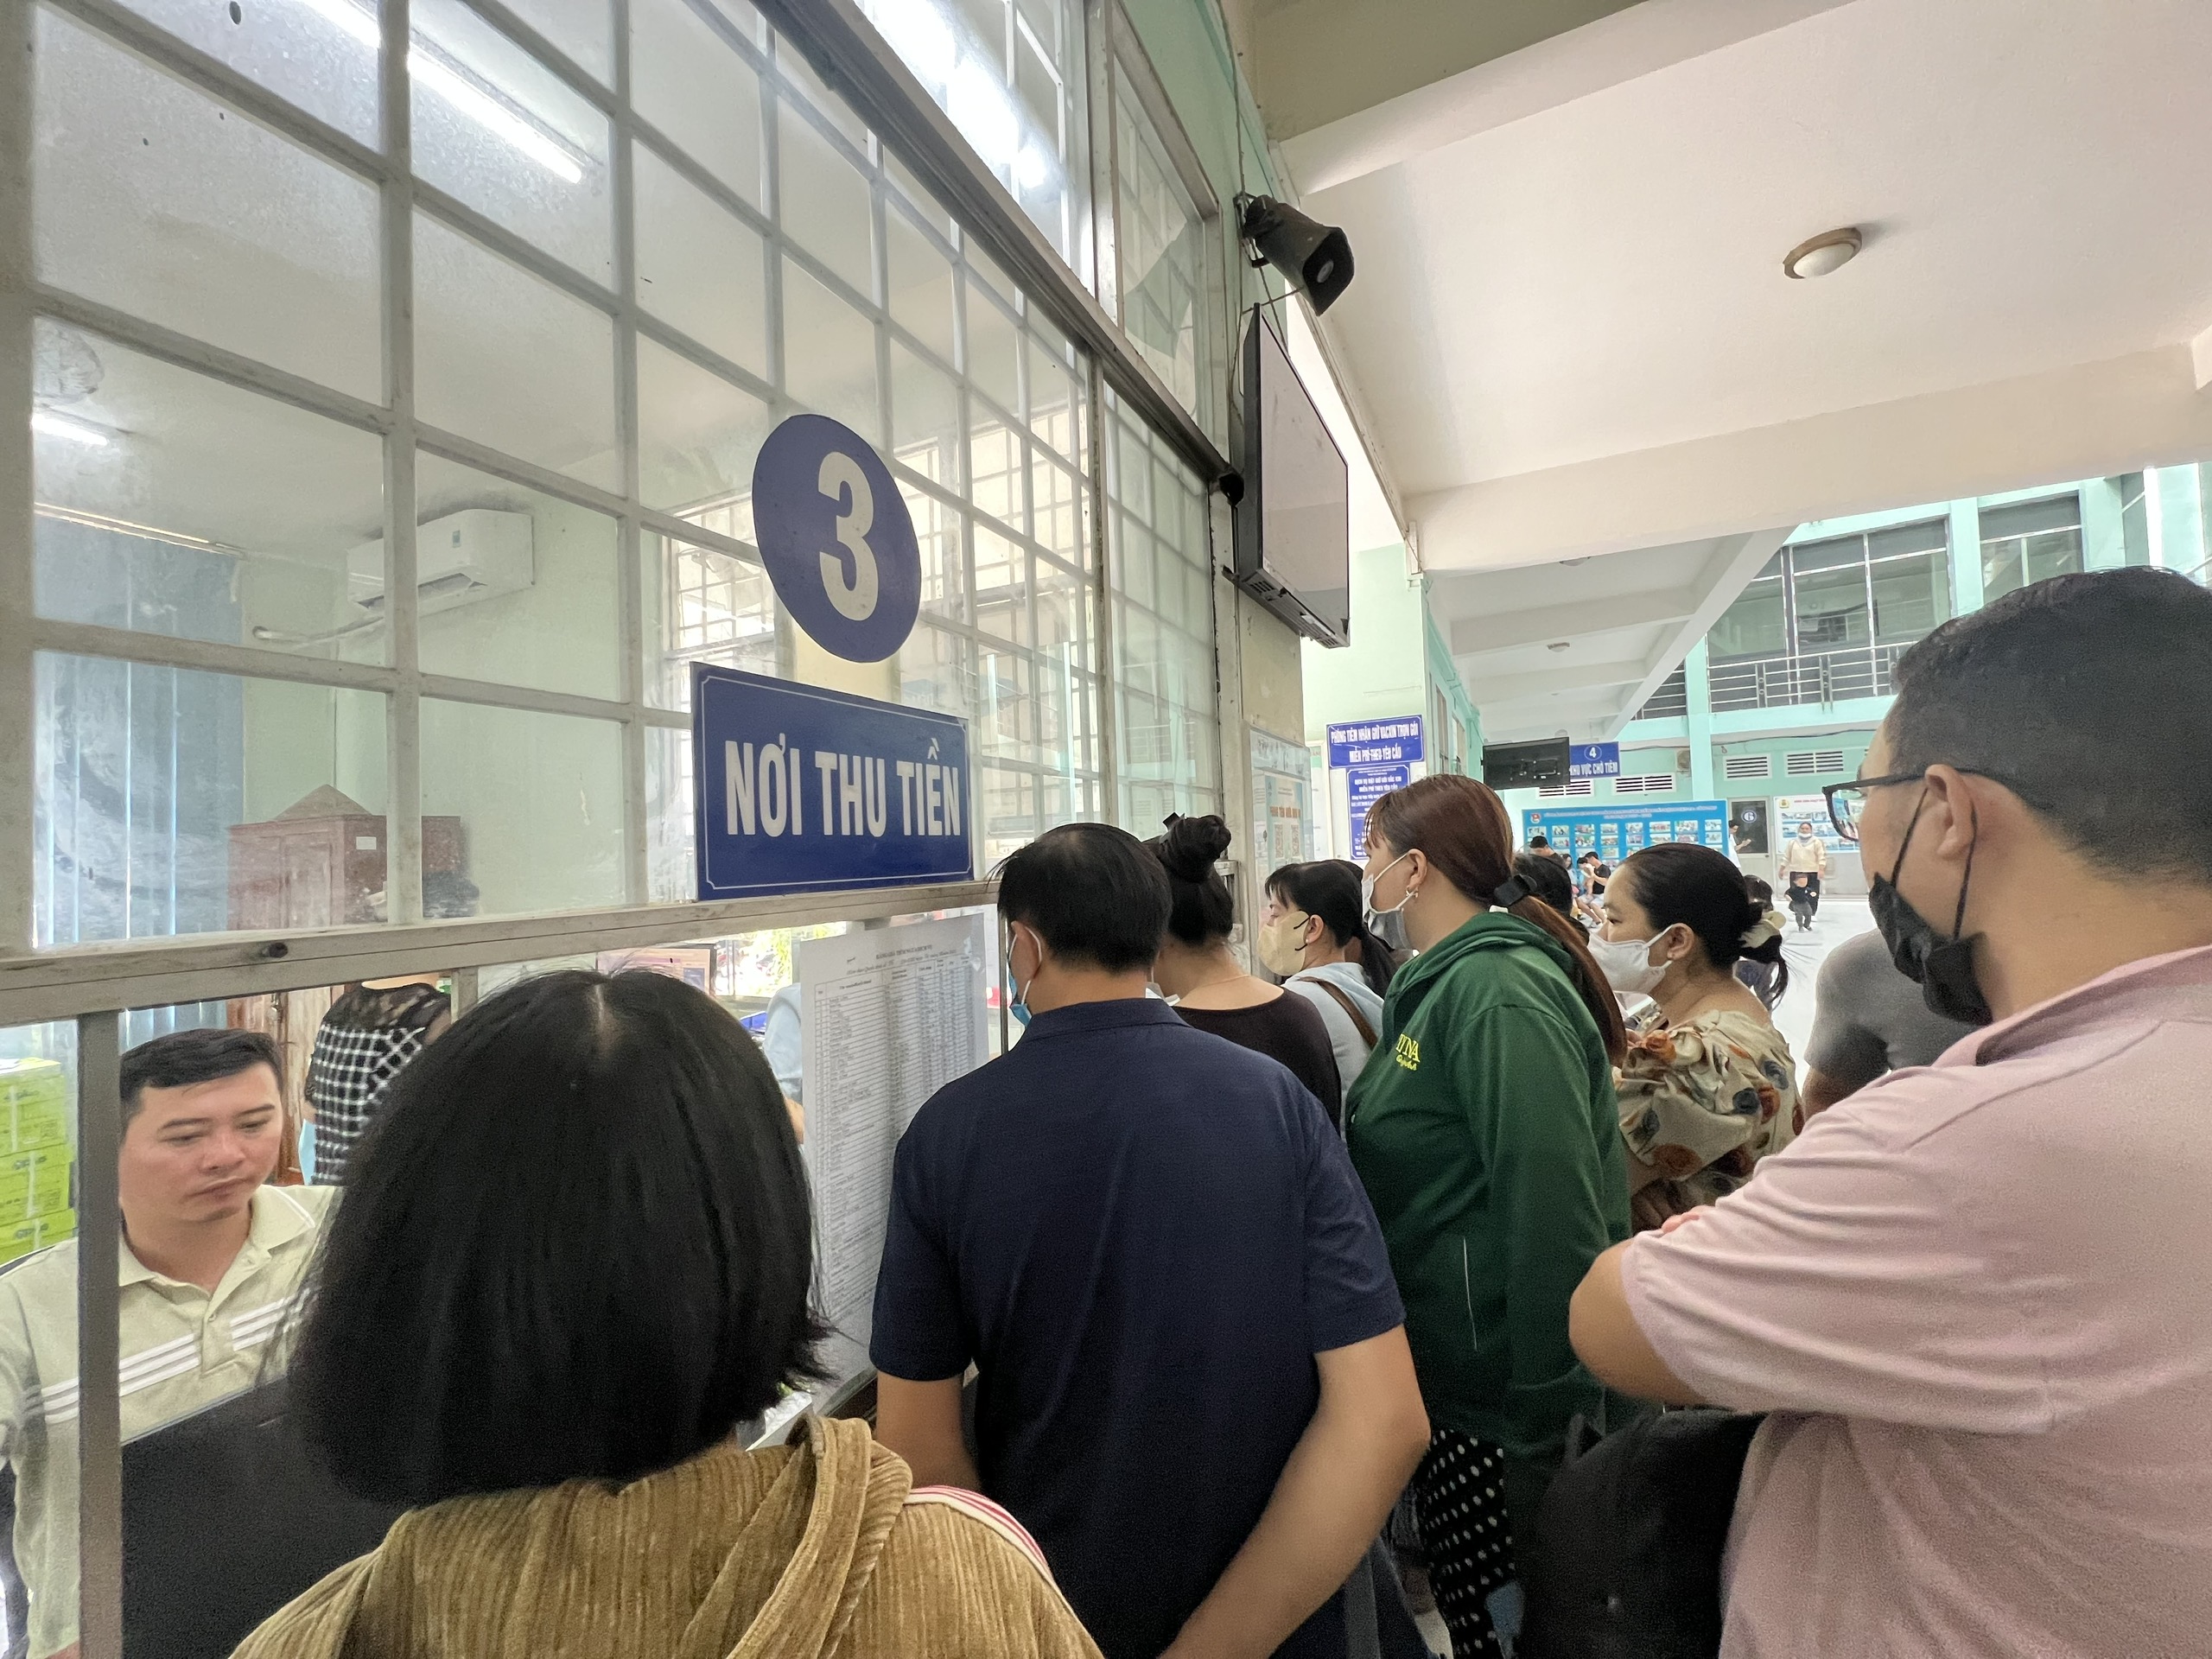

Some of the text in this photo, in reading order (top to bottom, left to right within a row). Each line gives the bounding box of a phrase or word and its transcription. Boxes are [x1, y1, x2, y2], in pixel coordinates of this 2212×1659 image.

[818, 451, 880, 621] 3
[725, 733, 961, 837] NƠI THU TIỀN
[1589, 747, 1597, 758] 4
